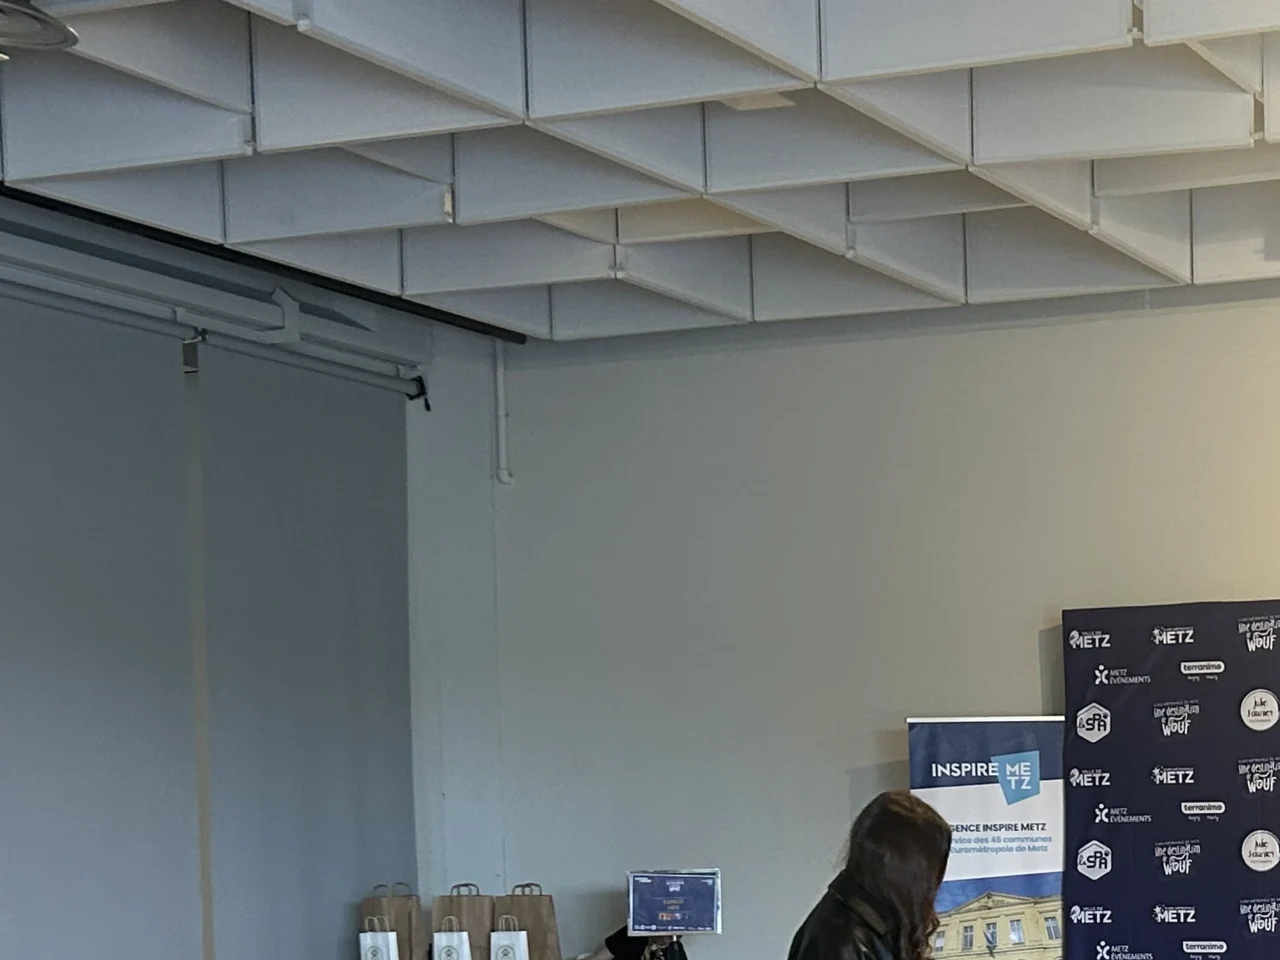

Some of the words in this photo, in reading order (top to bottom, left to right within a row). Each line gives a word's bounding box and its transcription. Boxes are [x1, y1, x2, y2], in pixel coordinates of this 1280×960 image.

[1070, 634, 1111, 649] METZ
[1154, 630, 1194, 645] METZ
[1110, 668, 1128, 676] METZ
[1085, 713, 1107, 731] SPA
[932, 763, 999, 777] INSPIRE
[1070, 772, 1111, 787] METZ
[1154, 770, 1195, 785] METZ
[1110, 807, 1128, 815] METZ
[950, 823, 981, 833] GENCE
[982, 823, 1019, 832] INSPIRE
[1020, 823, 1047, 831] METZ
[973, 836, 989, 844] des
[1086, 851, 1107, 869] SPA
[1072, 910, 1112, 924] METZ
[1156, 910, 1196, 923] METZ
[1111, 945, 1129, 953] METZ
